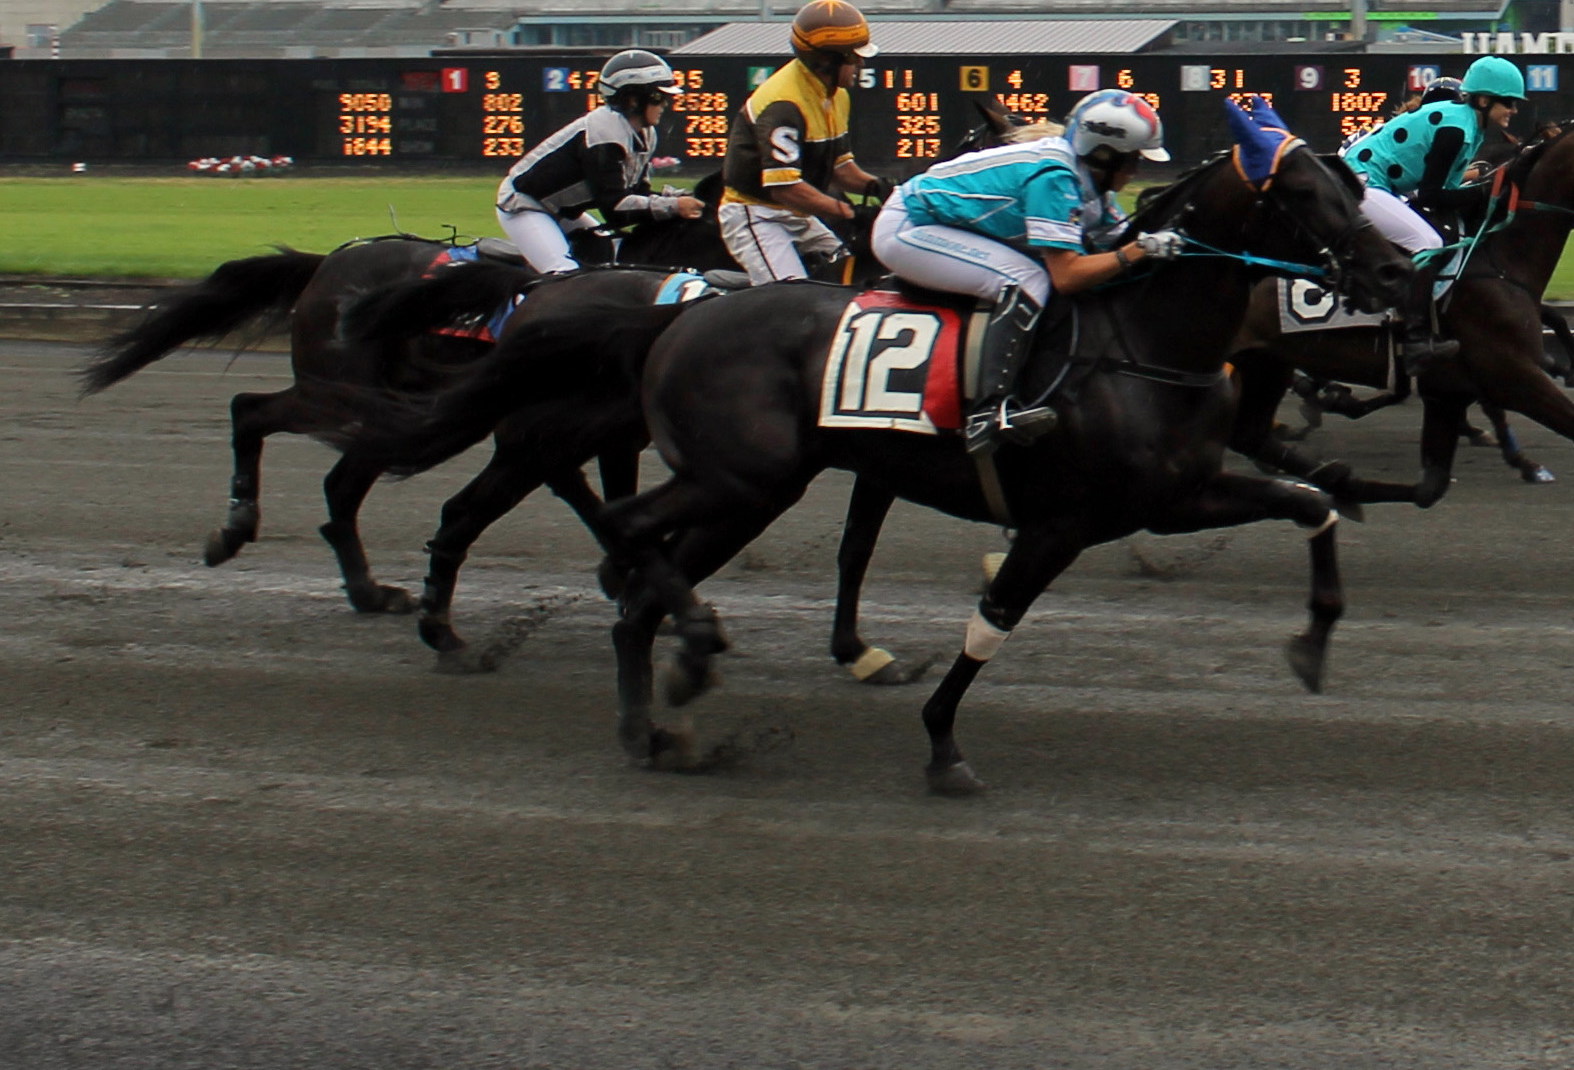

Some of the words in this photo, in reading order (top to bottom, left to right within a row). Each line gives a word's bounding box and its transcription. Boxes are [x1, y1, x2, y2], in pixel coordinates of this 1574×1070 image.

[548, 69, 564, 90] 2
[859, 68, 876, 89] 5
[967, 68, 982, 88] 6
[1006, 70, 1023, 89] 4
[1077, 67, 1092, 88] 7
[1117, 69, 1134, 89] 6
[1300, 67, 1319, 88] 9
[1344, 68, 1360, 88] 3
[1411, 67, 1437, 88] 10
[1529, 68, 1555, 88] 11
[672, 92, 728, 112] 2528
[896, 92, 939, 112] 601
[1332, 92, 1387, 112] 1807
[339, 115, 392, 133] 3194
[483, 115, 524, 134] 276
[896, 115, 941, 134] 325
[483, 137, 525, 157] 233
[686, 137, 728, 157] 333
[770, 126, 799, 163] S
[896, 138, 941, 158] 213
[839, 313, 940, 413] 12
